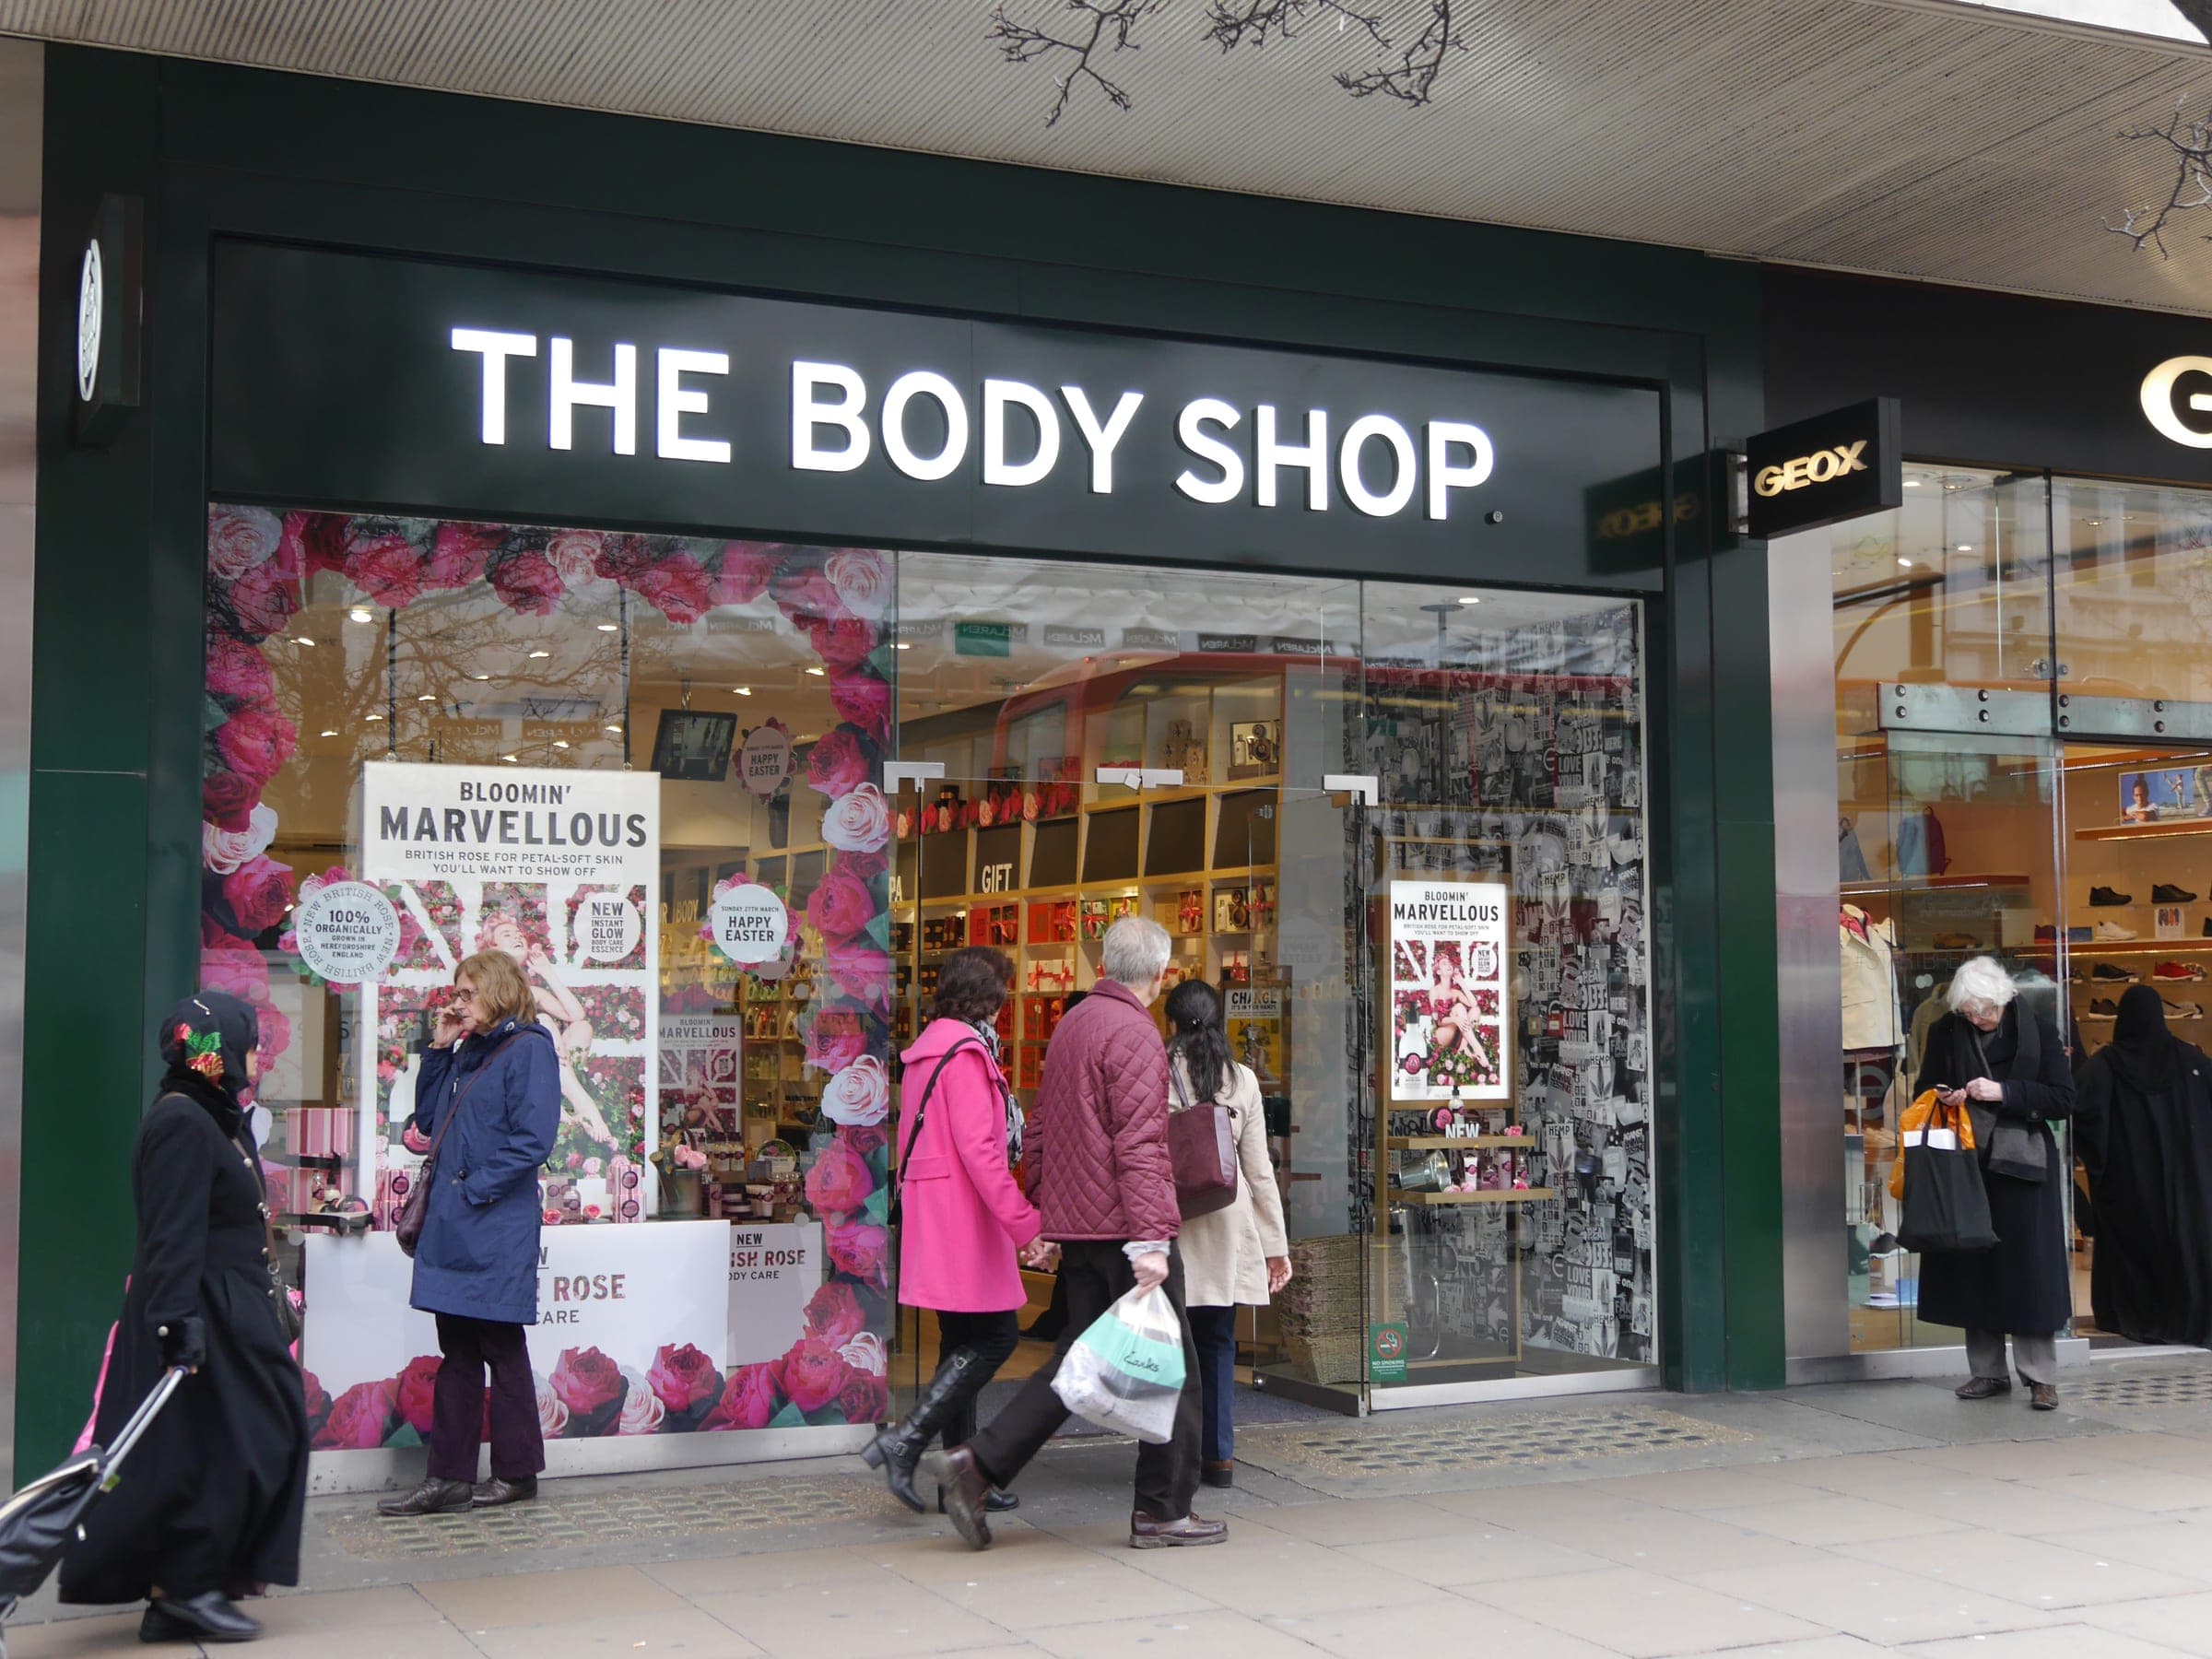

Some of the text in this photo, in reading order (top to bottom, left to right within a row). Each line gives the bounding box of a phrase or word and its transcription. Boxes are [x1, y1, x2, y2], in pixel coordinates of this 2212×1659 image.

[451, 327, 1494, 520] THE BODY SHOP
[1754, 440, 1868, 497] GEOX
[751, 752, 779, 765] HAPPY
[1559, 756, 1582, 773] LOVE
[748, 765, 781, 777] EASTER
[460, 781, 571, 805] BLOOMIN'
[1584, 795, 1605, 807] HEMP
[380, 806, 647, 848] MARVELLOUS
[405, 849, 623, 865] BRITISH ROSE FOR PETAL-SOFT SKIN
[433, 864, 596, 877] YOU'LL WANT TO SHOW OFF
[982, 863, 1013, 894] GIFT
[1544, 873, 1565, 885] HEMP
[1424, 890, 1469, 901] BLOOMIN'
[302, 887, 394, 930] NEW BRITISH ROSE
[592, 902, 624, 916] NEW
[677, 899, 699, 924] BODY
[1394, 903, 1500, 922] MARVELLOUS
[329, 910, 371, 924] 100%
[592, 919, 623, 928] INSTANT
[728, 916, 771, 929] HAPPY
[315, 924, 382, 935] ORGANICALLY
[592, 928, 624, 939] GLOW
[725, 930, 774, 942] EASTER
[320, 943, 376, 951] HEREFORDSHIRE
[302, 935, 394, 978] NEW BRITISH ROSE
[1563, 1010, 1587, 1029] LOVE
[1590, 1055, 1610, 1065] HEMP
[1445, 1123, 1479, 1139] NEW
[1548, 1125, 1571, 1136] HEMP
[736, 1232, 763, 1245] NEW
[764, 1249, 806, 1267] ROSE
[750, 1270, 781, 1280] CARE
[1567, 1265, 1592, 1286] LOVE
[553, 1273, 626, 1303] ROSE
[535, 1310, 580, 1325] ARE
[1594, 1313, 1615, 1325] HEMP
